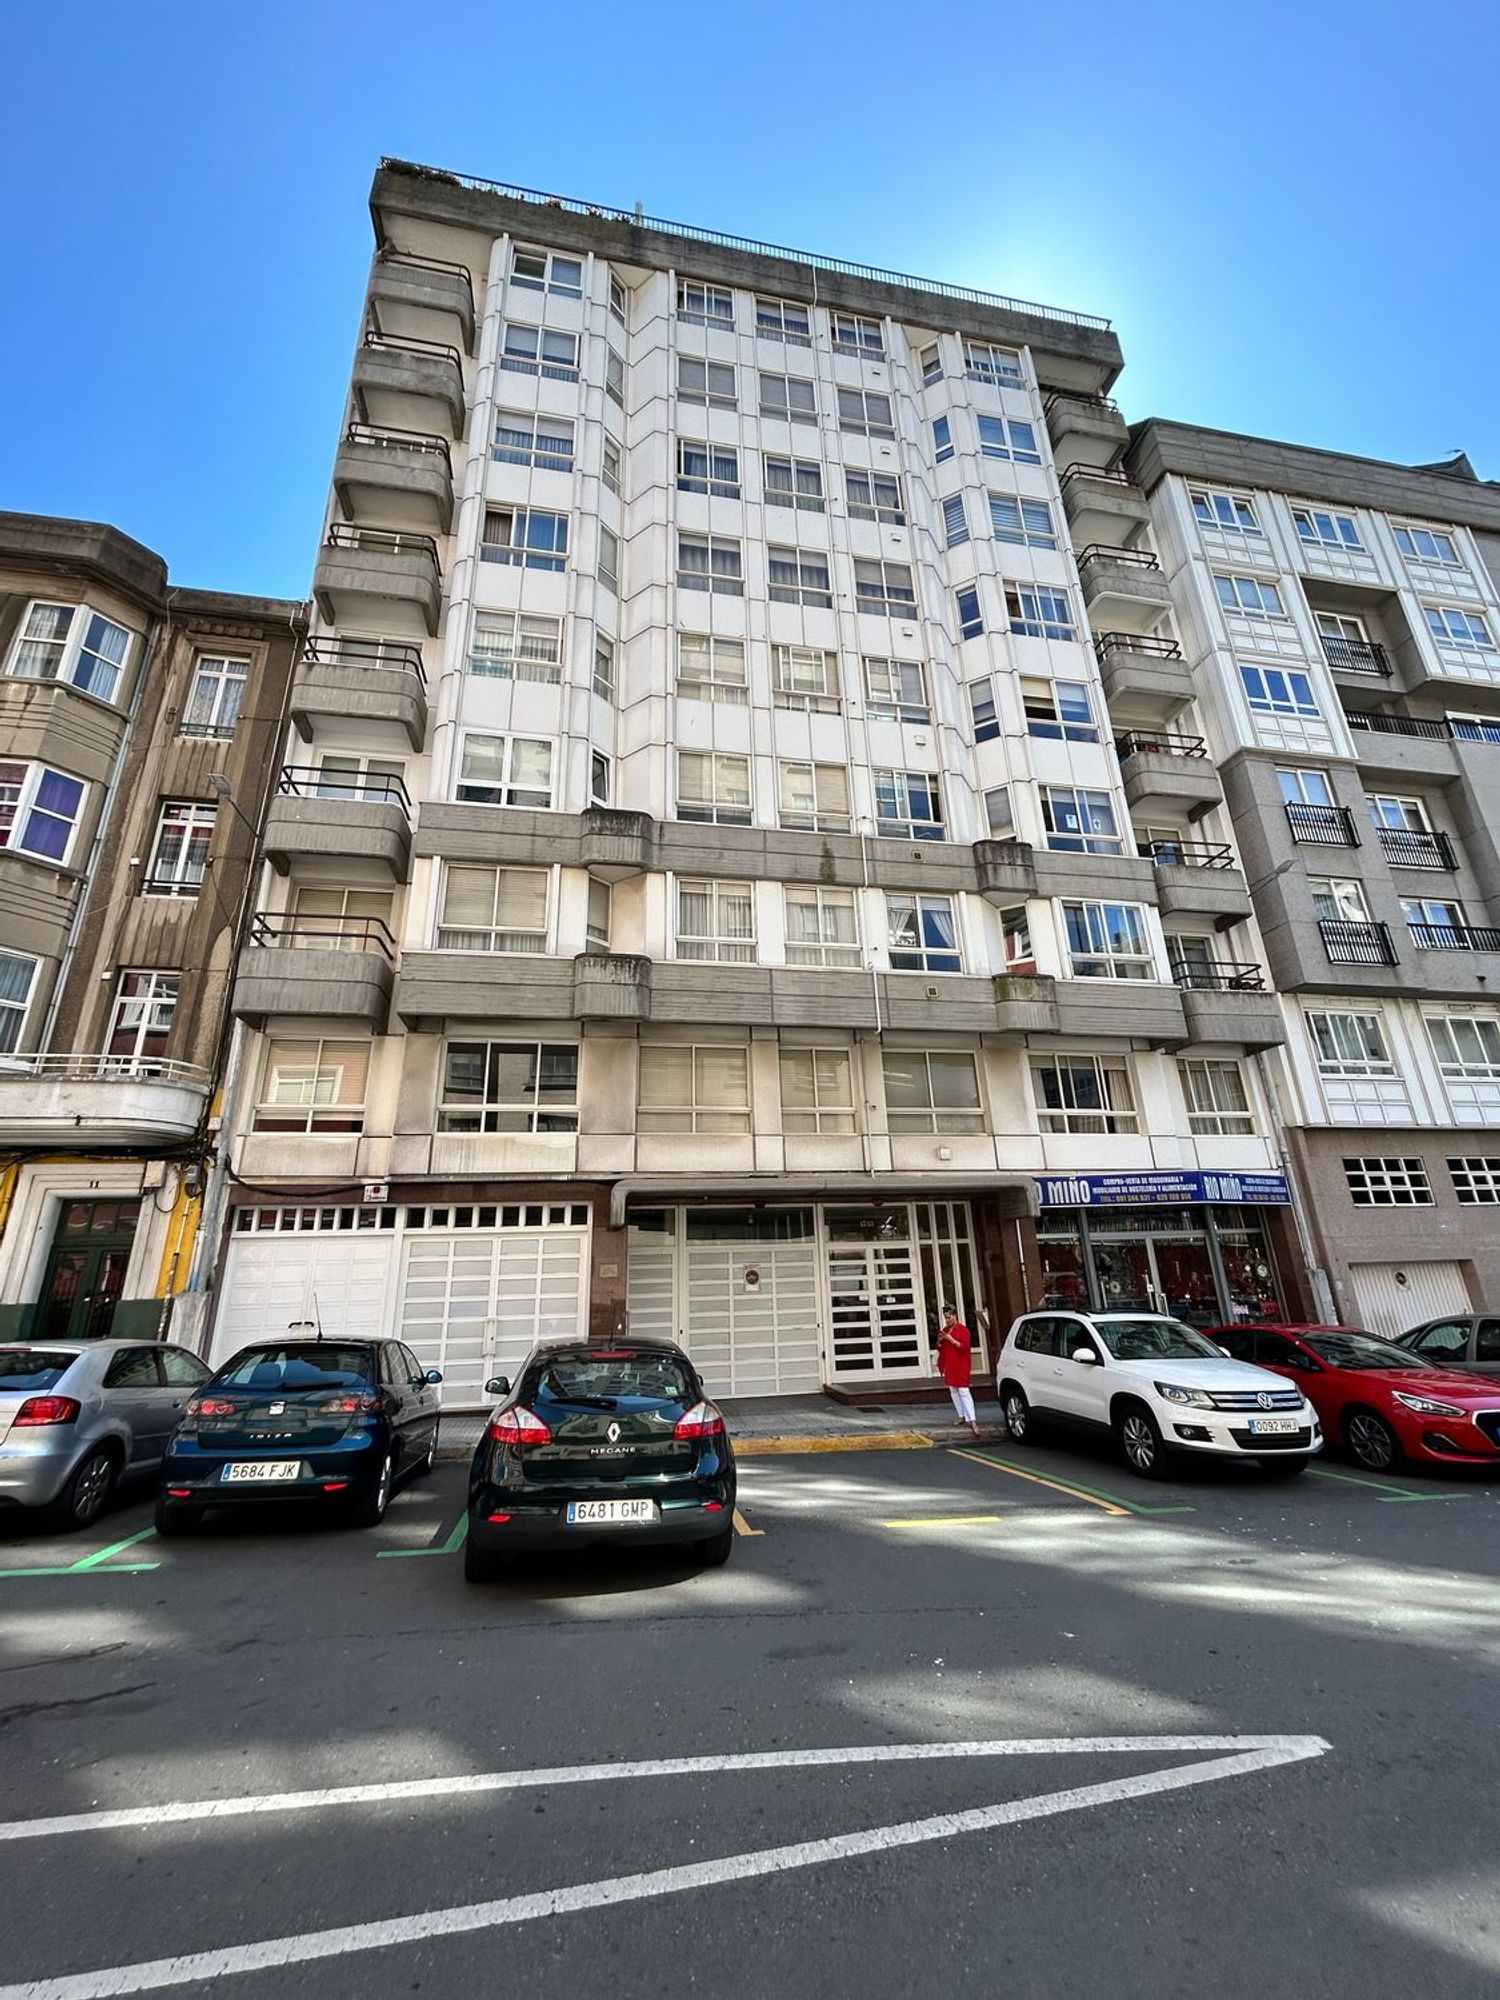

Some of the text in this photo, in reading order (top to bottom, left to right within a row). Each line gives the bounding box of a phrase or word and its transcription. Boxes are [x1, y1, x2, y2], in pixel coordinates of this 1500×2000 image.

[1047, 1176, 1091, 1204] MIÑO
[1256, 1421, 1280, 1431] 0092
[232, 1463, 296, 1478] 5684 FJK
[577, 1501, 649, 1519] 6481 GMP
